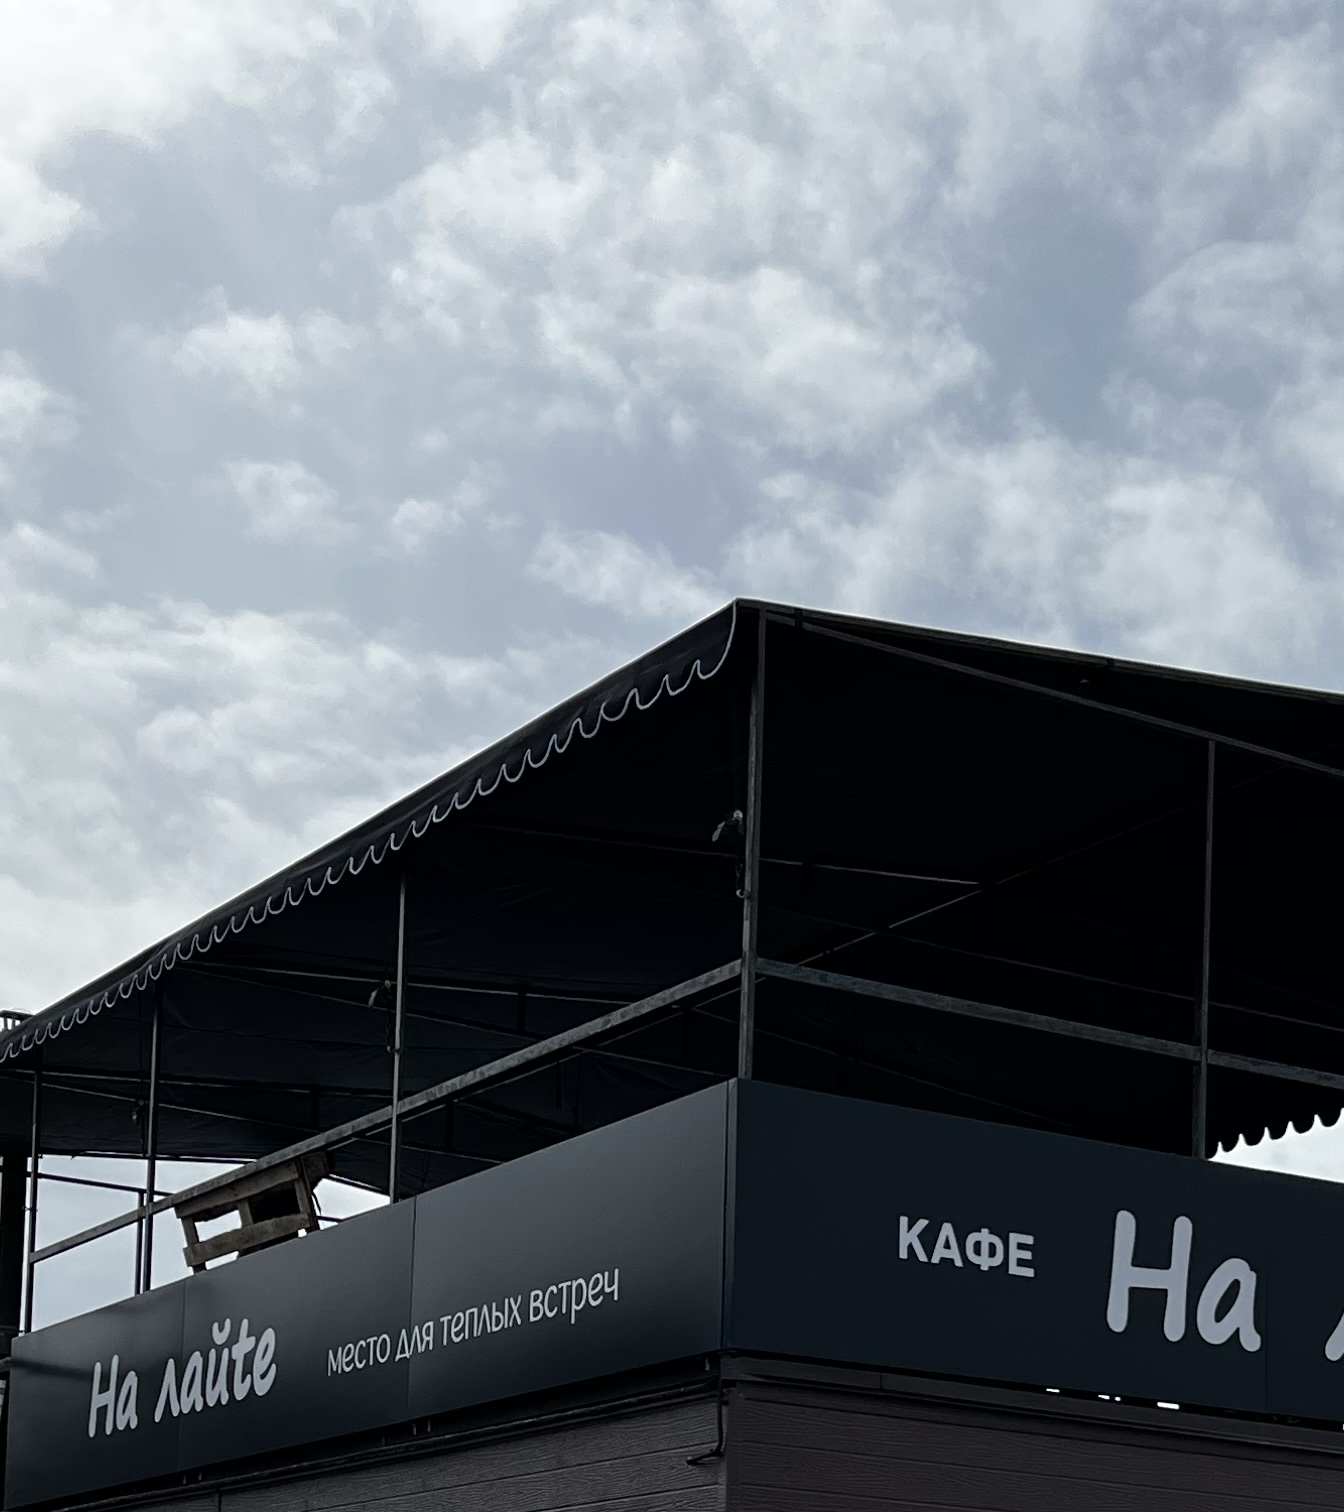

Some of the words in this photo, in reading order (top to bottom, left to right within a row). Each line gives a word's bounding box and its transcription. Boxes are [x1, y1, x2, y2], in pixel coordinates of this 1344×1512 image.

[899, 1216, 1034, 1277] КАФЕ
[1107, 1211, 1261, 1351] На
[328, 1334, 390, 1377] место
[395, 1320, 434, 1361] для
[440, 1295, 521, 1345] теплых
[529, 1269, 619, 1325] встреч
[89, 1355, 138, 1437] На
